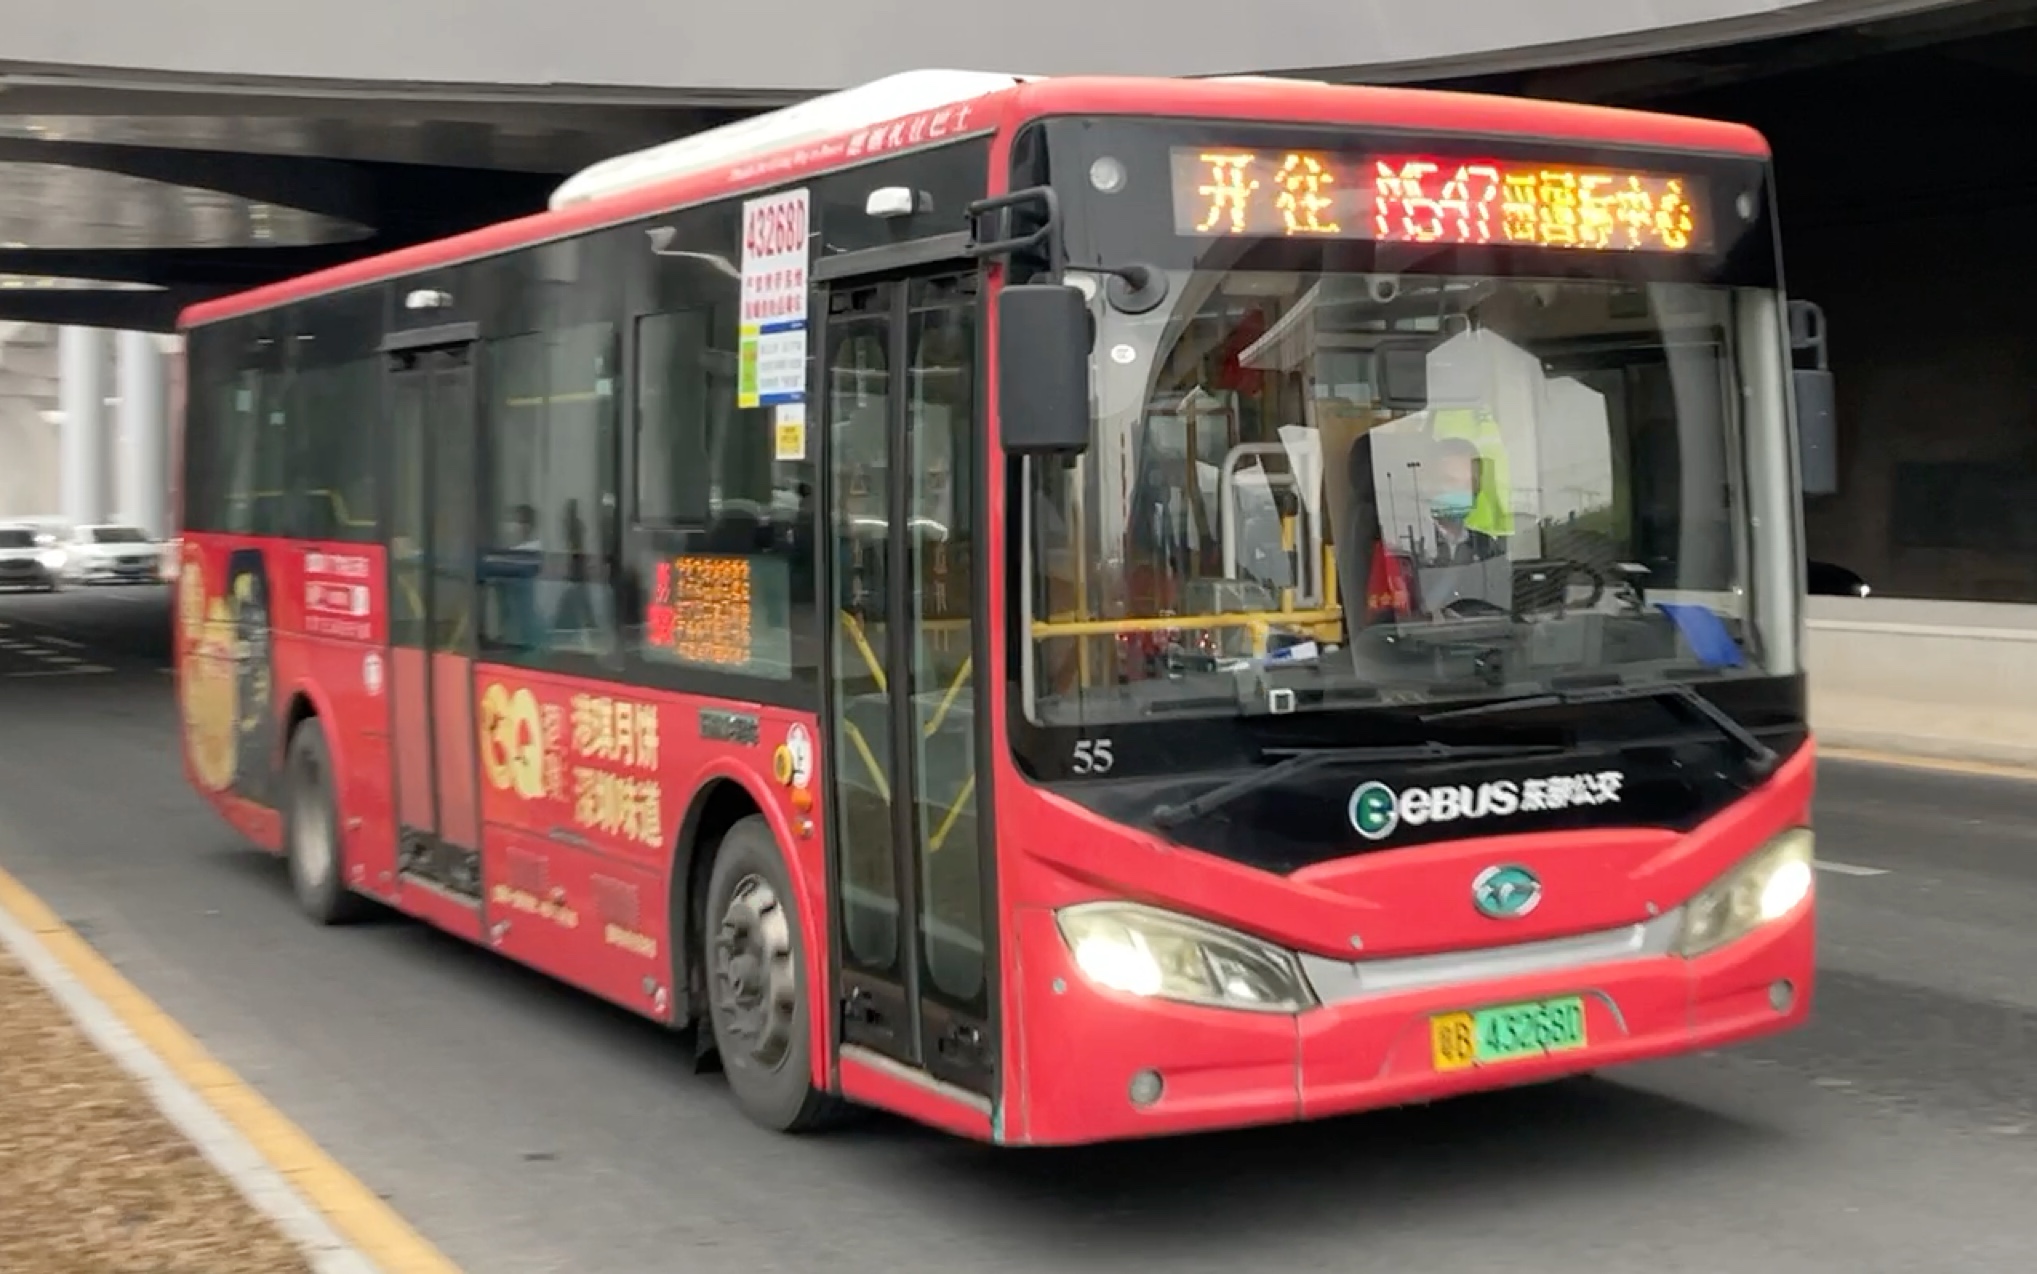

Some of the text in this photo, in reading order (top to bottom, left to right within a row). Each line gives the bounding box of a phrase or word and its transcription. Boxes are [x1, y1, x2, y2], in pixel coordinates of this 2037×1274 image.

[746, 198, 806, 258] 432680
[1072, 738, 1114, 774] 55
[1518, 770, 1624, 812] 东部公交
